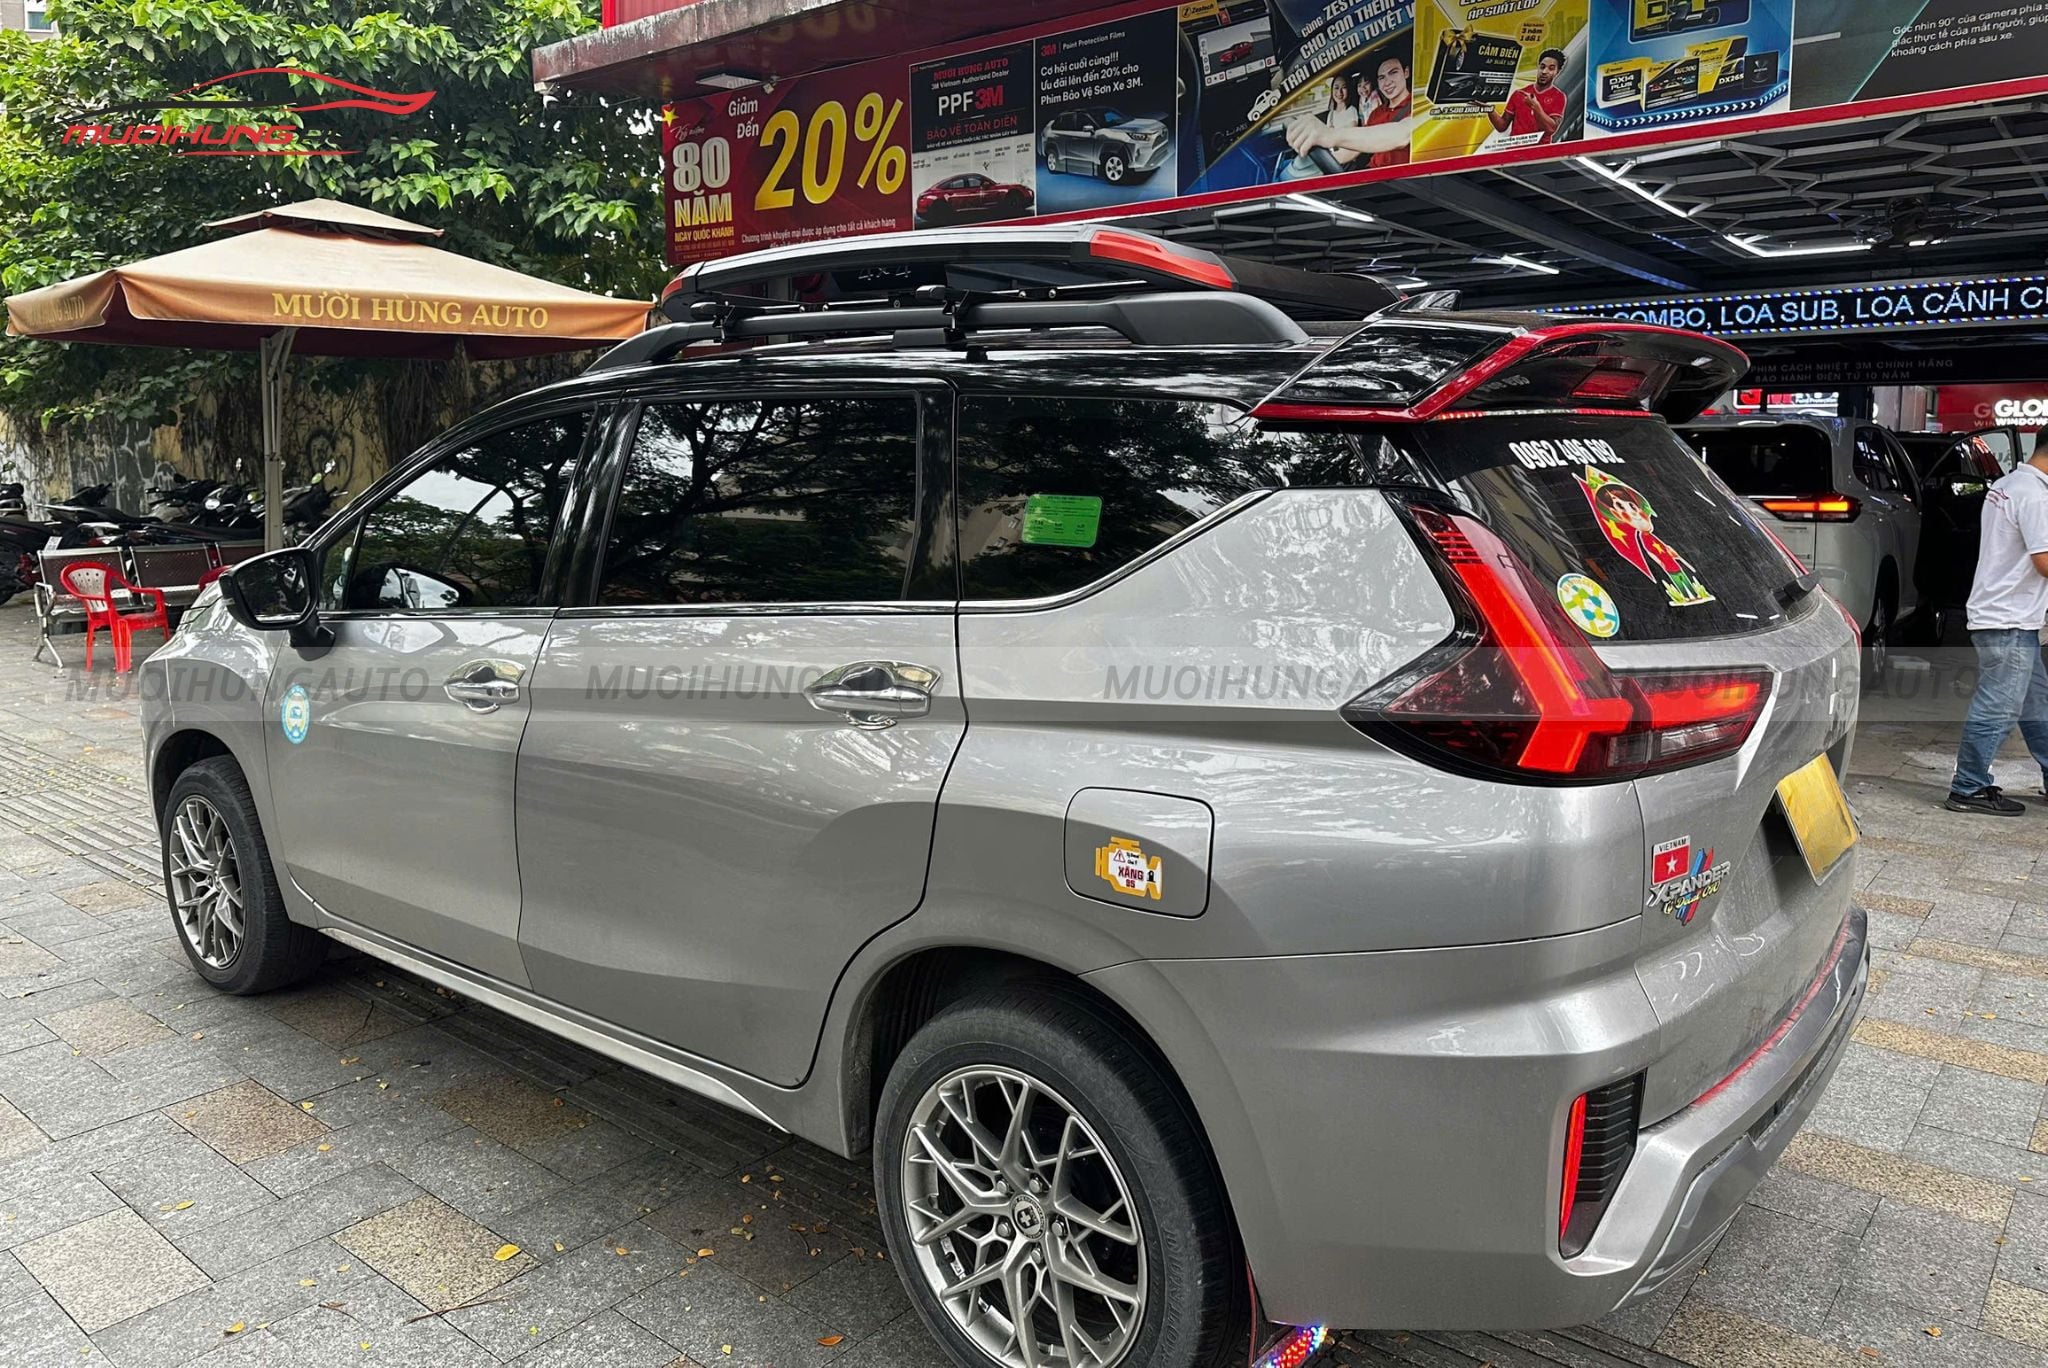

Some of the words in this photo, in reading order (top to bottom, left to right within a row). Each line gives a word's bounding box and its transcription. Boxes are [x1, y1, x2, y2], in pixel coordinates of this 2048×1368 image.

[1361, 8, 1403, 41] TUYỆT
[1978, 8, 2018, 21] camera
[1041, 43, 1056, 56] 3M
[1078, 35, 1108, 47] Protection
[1300, 32, 1327, 59] CHO
[1326, 14, 1355, 41] CON
[1953, 36, 1977, 50] phía
[1978, 34, 1998, 45] sau
[1478, 42, 1498, 58] CẢM
[1499, 45, 1520, 59] BIẾN
[984, 57, 1009, 71] AUTO
[1101, 66, 1120, 79] 20%
[1121, 64, 1139, 75] cho
[962, 71, 991, 85] Authorized
[992, 69, 1010, 79] Dealer
[1611, 81, 1633, 91] PLUS
[938, 90, 974, 117] PPF
[975, 84, 1005, 111] 3M
[1041, 93, 1061, 106] Phim
[1062, 89, 1080, 102] Bảo
[1113, 81, 1124, 92] Xe
[728, 99, 758, 118] Giảm
[736, 117, 759, 139] Đến
[754, 91, 907, 212] 20%
[672, 136, 731, 192] 80
[674, 189, 733, 229] NĂM
[836, 223, 847, 233] cho
[272, 290, 361, 320] MƯỜI
[371, 293, 462, 325] HÙNG
[470, 303, 549, 329] AUTO
[1720, 303, 1775, 327] LOA
[1780, 299, 1846, 323] SUB,
[1856, 294, 1915, 319] LOA
[1922, 286, 2009, 314] CÁNH
[2020, 286, 2048, 309] C
[1855, 361, 1872, 370] 3M
[1866, 371, 1878, 380] 10
[1508, 439, 1569, 469] 0962
[1554, 438, 1598, 464] 496
[1583, 438, 1626, 464] 692
[1658, 838, 1687, 852] VIETNAM
[1118, 865, 1144, 881] XĂNG
[1646, 860, 1731, 908] XPANDER
